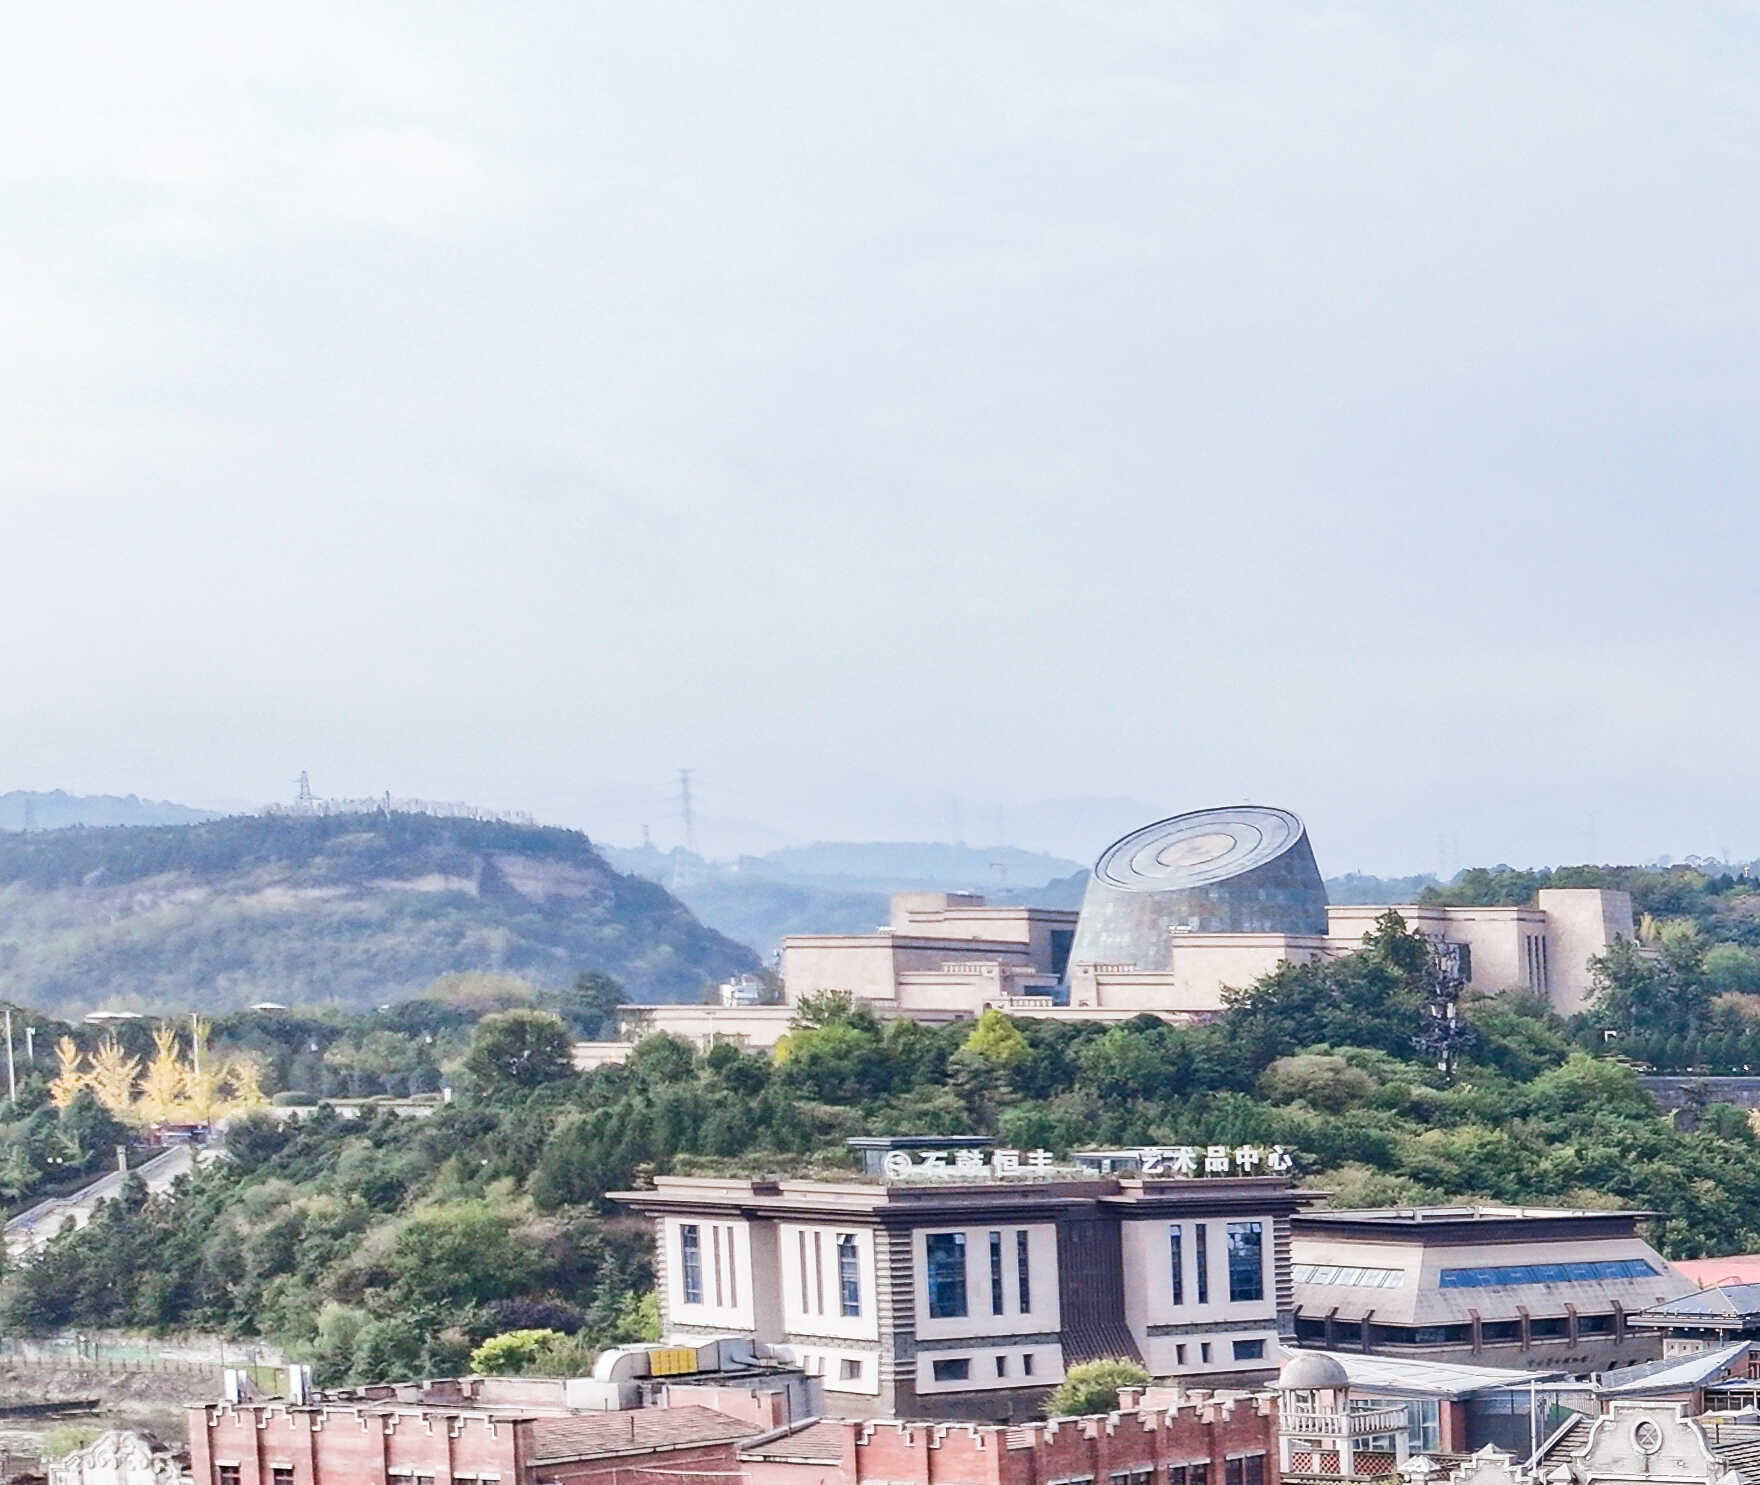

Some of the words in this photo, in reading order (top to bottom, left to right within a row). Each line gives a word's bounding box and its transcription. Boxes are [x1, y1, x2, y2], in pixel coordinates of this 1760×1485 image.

[1138, 1145, 1293, 1174] 艺术品中心
